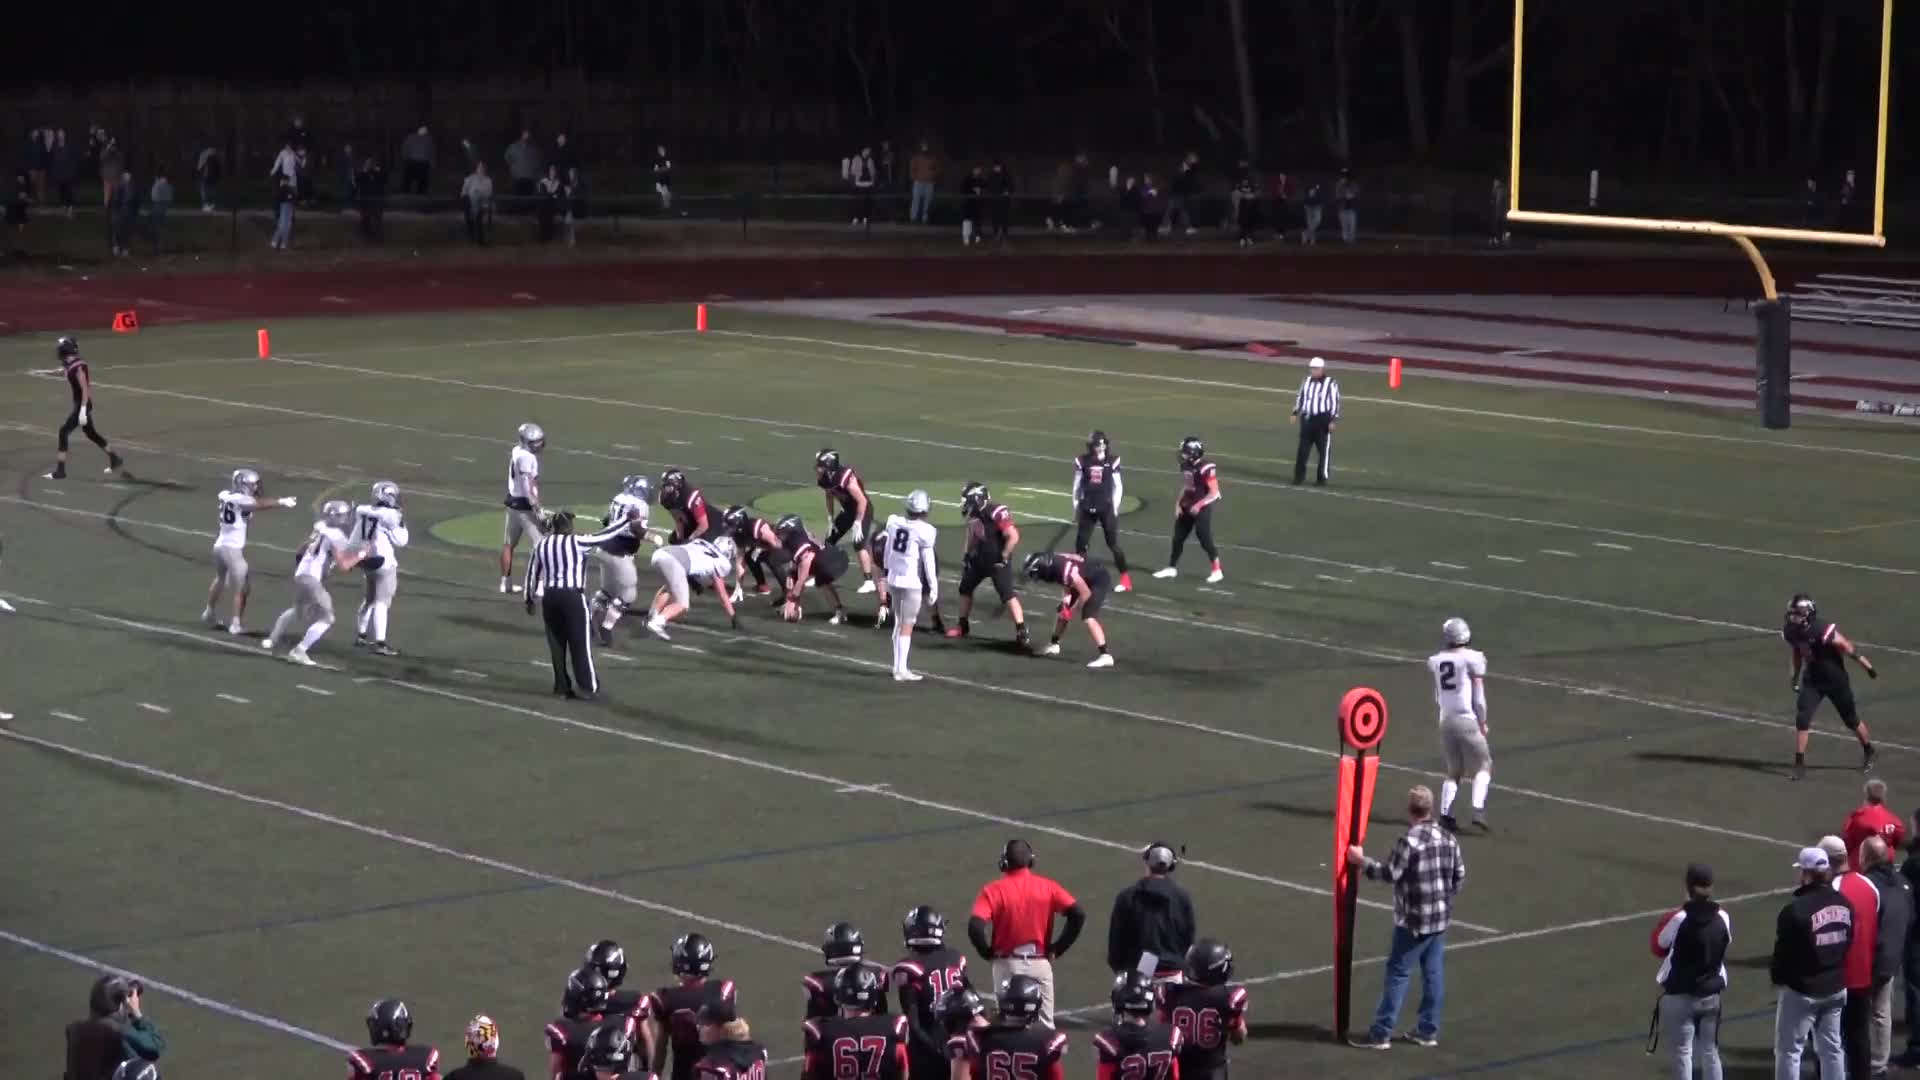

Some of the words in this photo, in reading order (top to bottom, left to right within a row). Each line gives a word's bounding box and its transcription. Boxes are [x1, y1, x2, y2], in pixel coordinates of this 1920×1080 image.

[361, 514, 379, 541] 17
[892, 528, 910, 554] 8
[1439, 661, 1457, 691] 2
[832, 1035, 887, 1080] 67
[1120, 1050, 1173, 1080] 27
